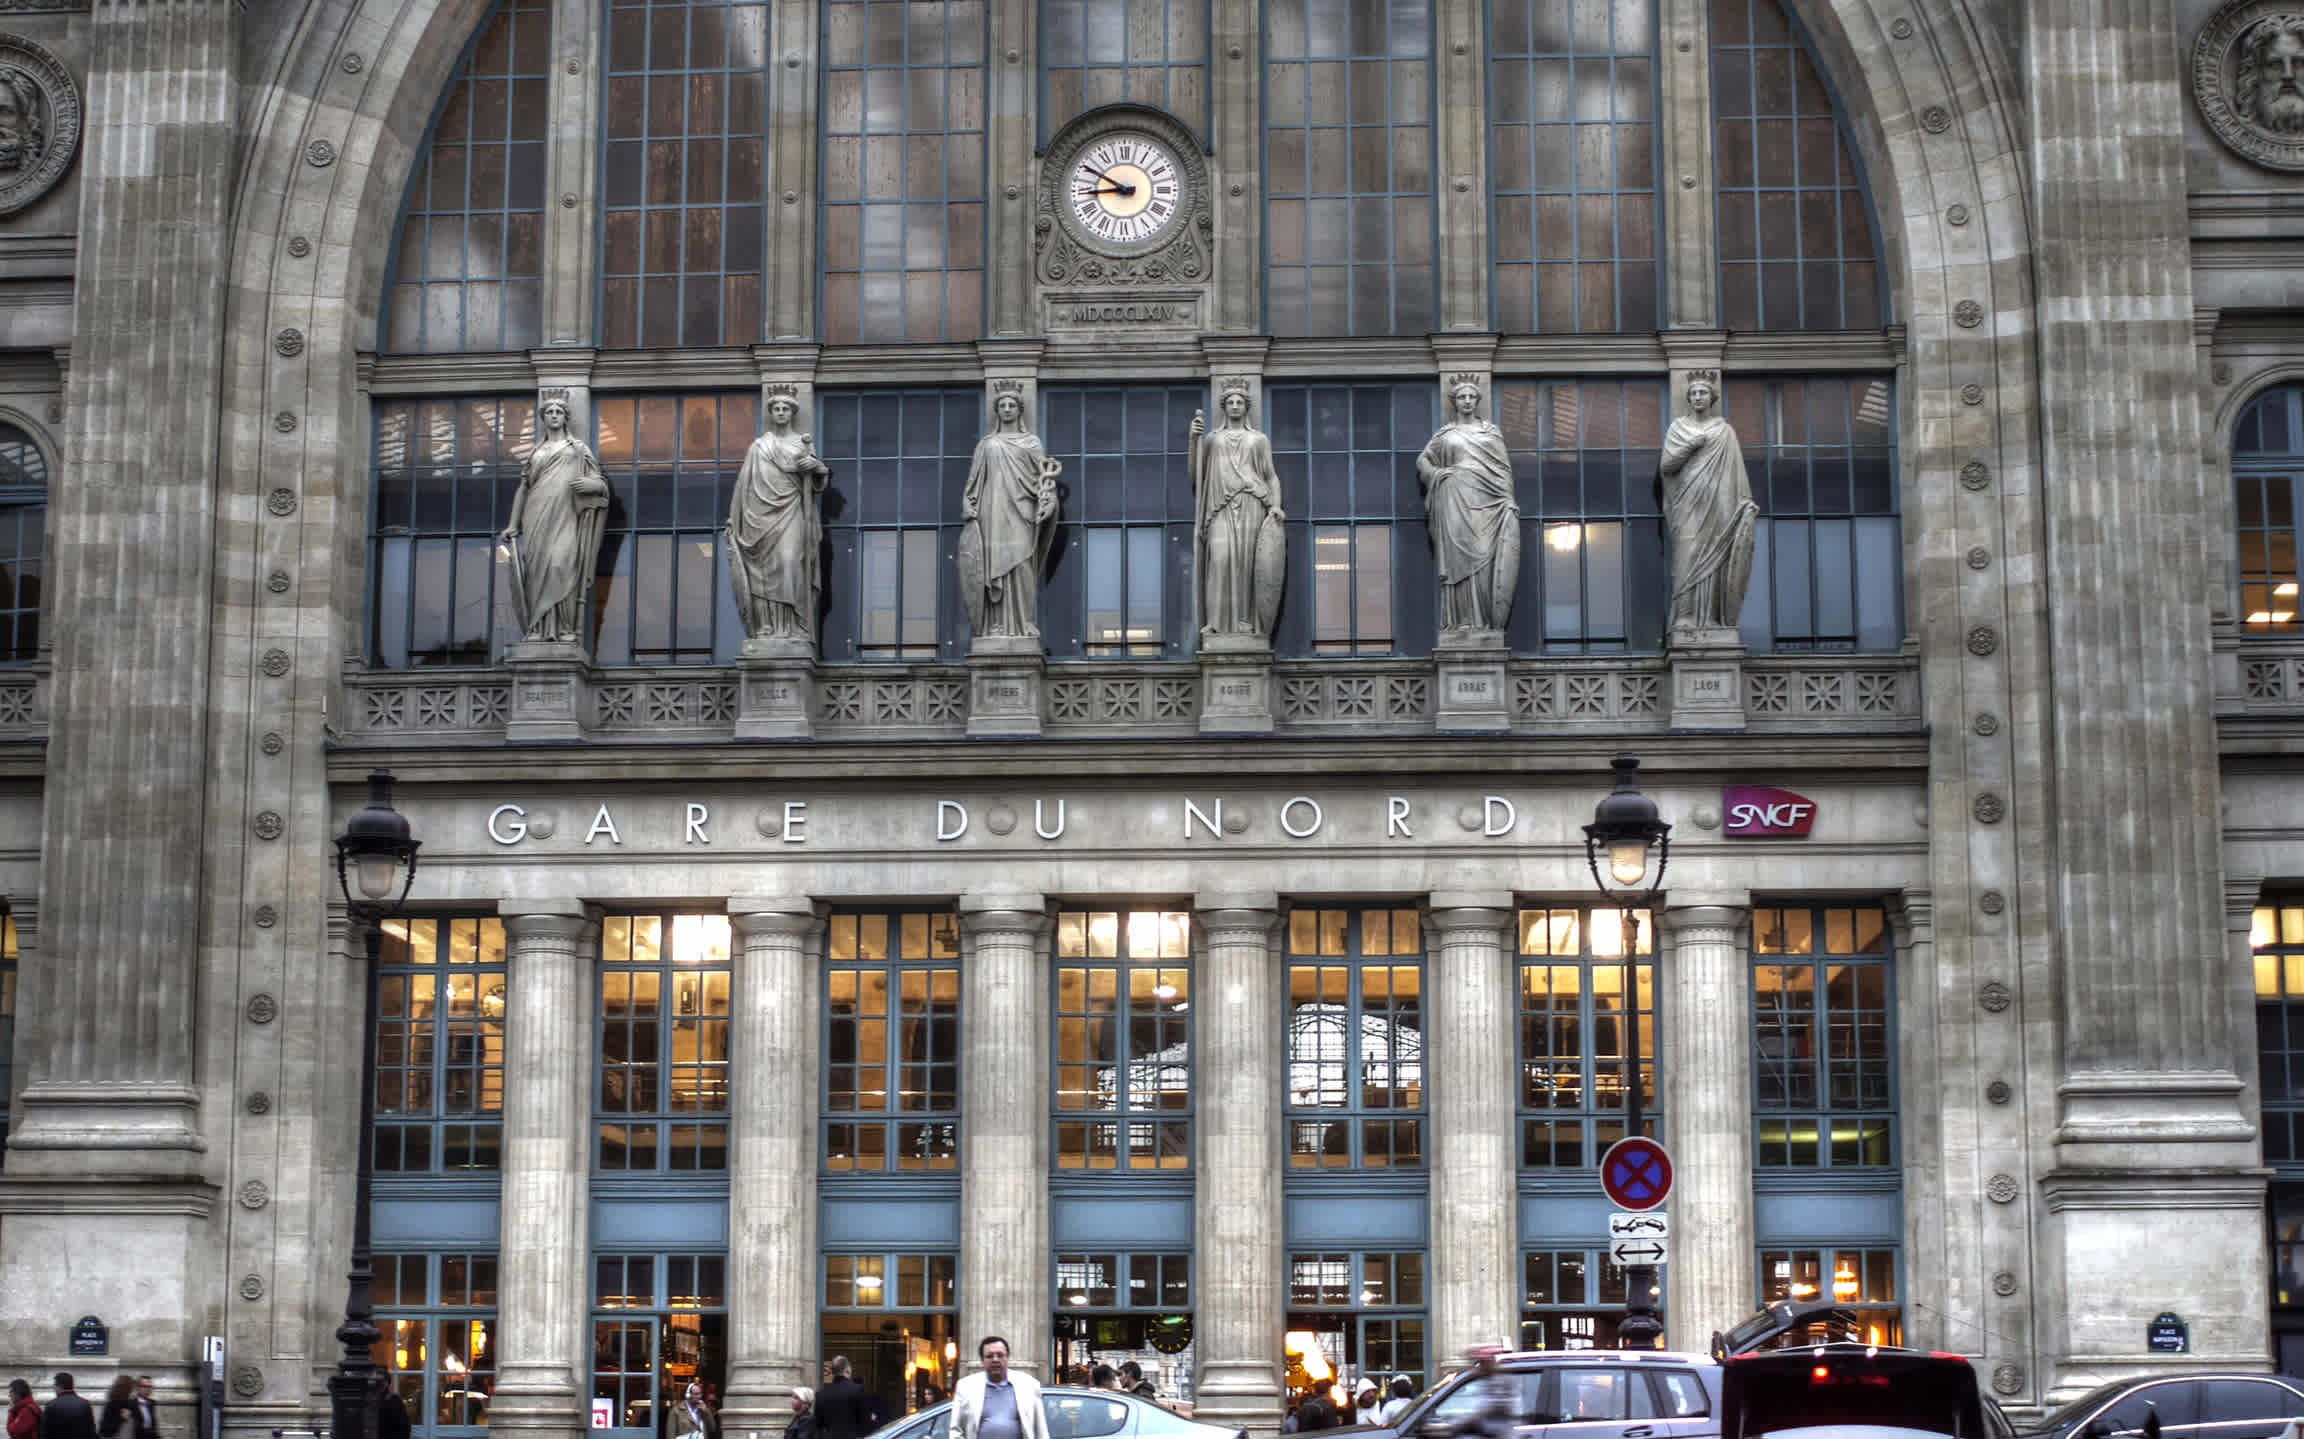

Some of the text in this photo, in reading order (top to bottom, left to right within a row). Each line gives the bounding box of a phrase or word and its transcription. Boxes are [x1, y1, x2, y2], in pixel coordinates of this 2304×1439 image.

[1072, 304, 1177, 322] MDCCCLXIV
[487, 797, 1516, 844] GARE DU NORD
[1728, 803, 1813, 828] SNCF
